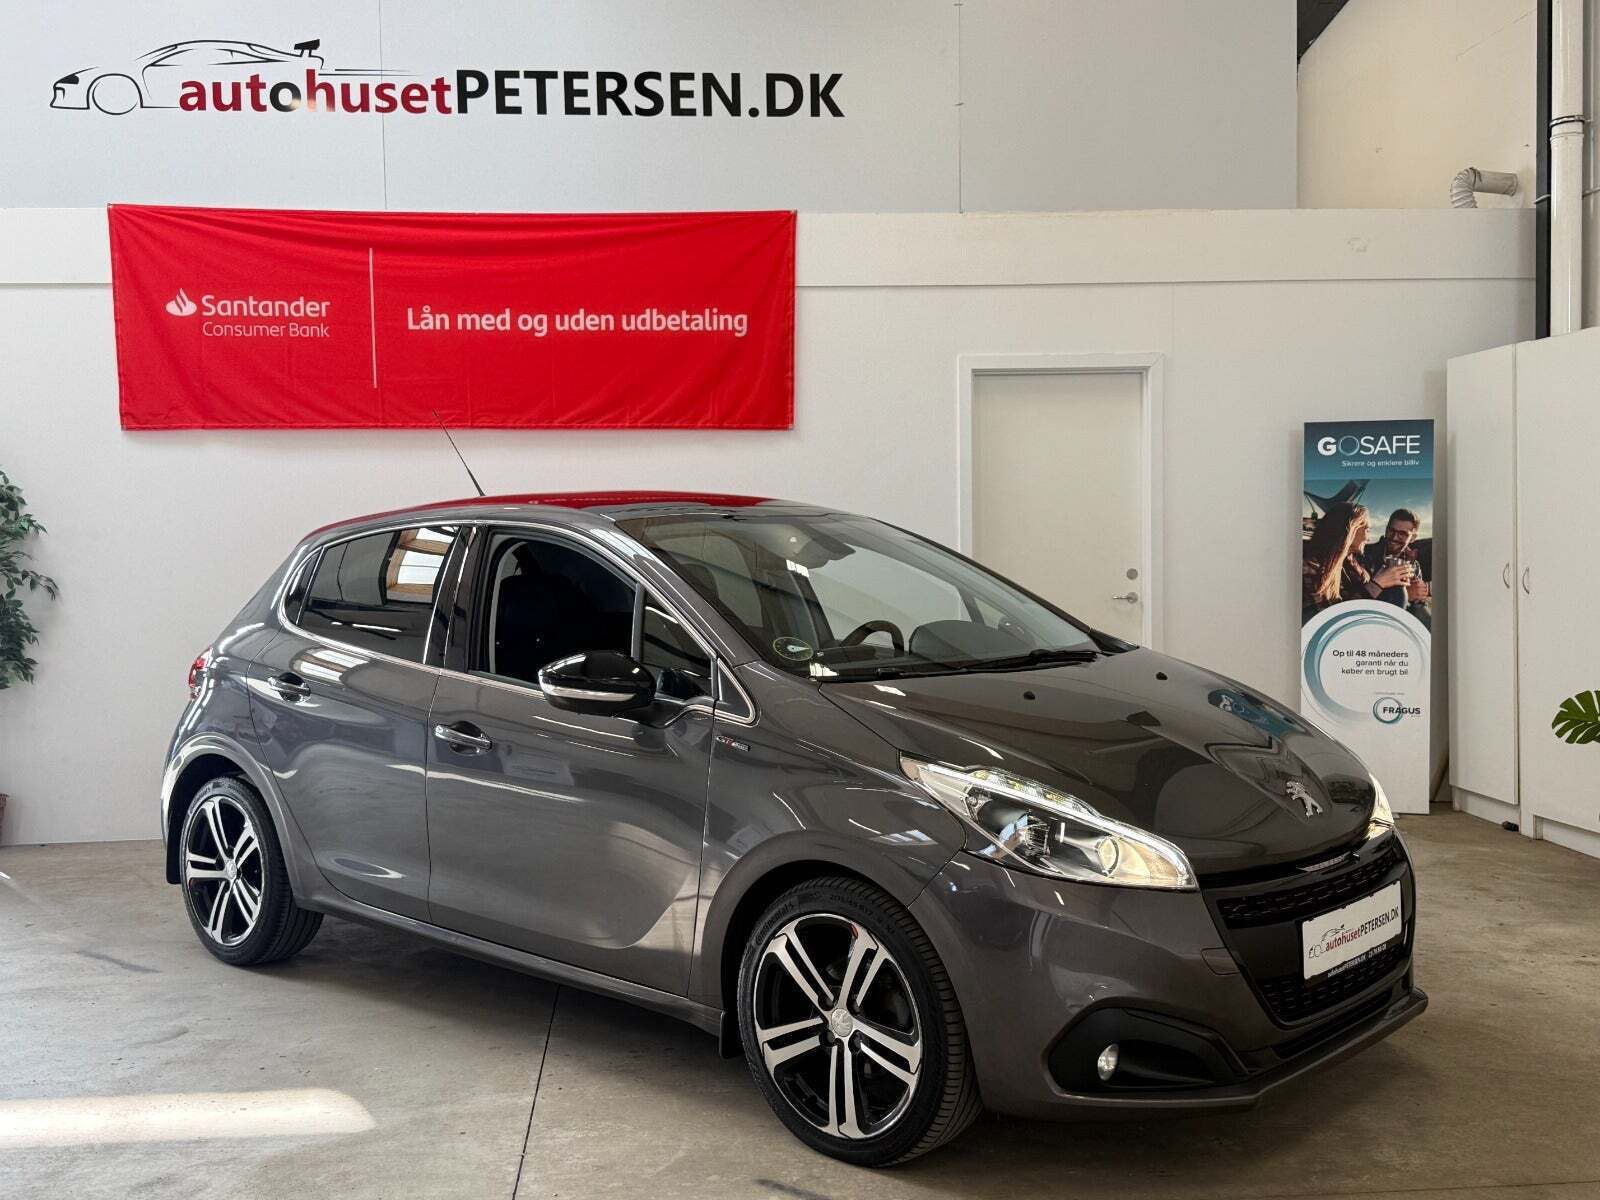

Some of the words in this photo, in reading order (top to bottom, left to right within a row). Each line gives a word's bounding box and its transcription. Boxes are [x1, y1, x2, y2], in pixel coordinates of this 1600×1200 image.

[178, 69, 846, 118] autohusetPETERSEN.DK
[201, 294, 331, 318] Santander
[202, 321, 286, 338] Consumer
[289, 322, 330, 338] Bank
[407, 305, 450, 331] Lån
[456, 308, 512, 331] med
[517, 312, 549, 338] og
[554, 309, 615, 332] uden
[621, 308, 749, 338] udbetaling
[1317, 434, 1421, 457] GOSAFE
[1332, 650, 1344, 658] Op
[1368, 650, 1409, 658] måneders
[1377, 668, 1397, 676] brugt
[1382, 706, 1421, 715] FRAGUS
[1325, 906, 1400, 952] autohusetPETERSEN.DK
